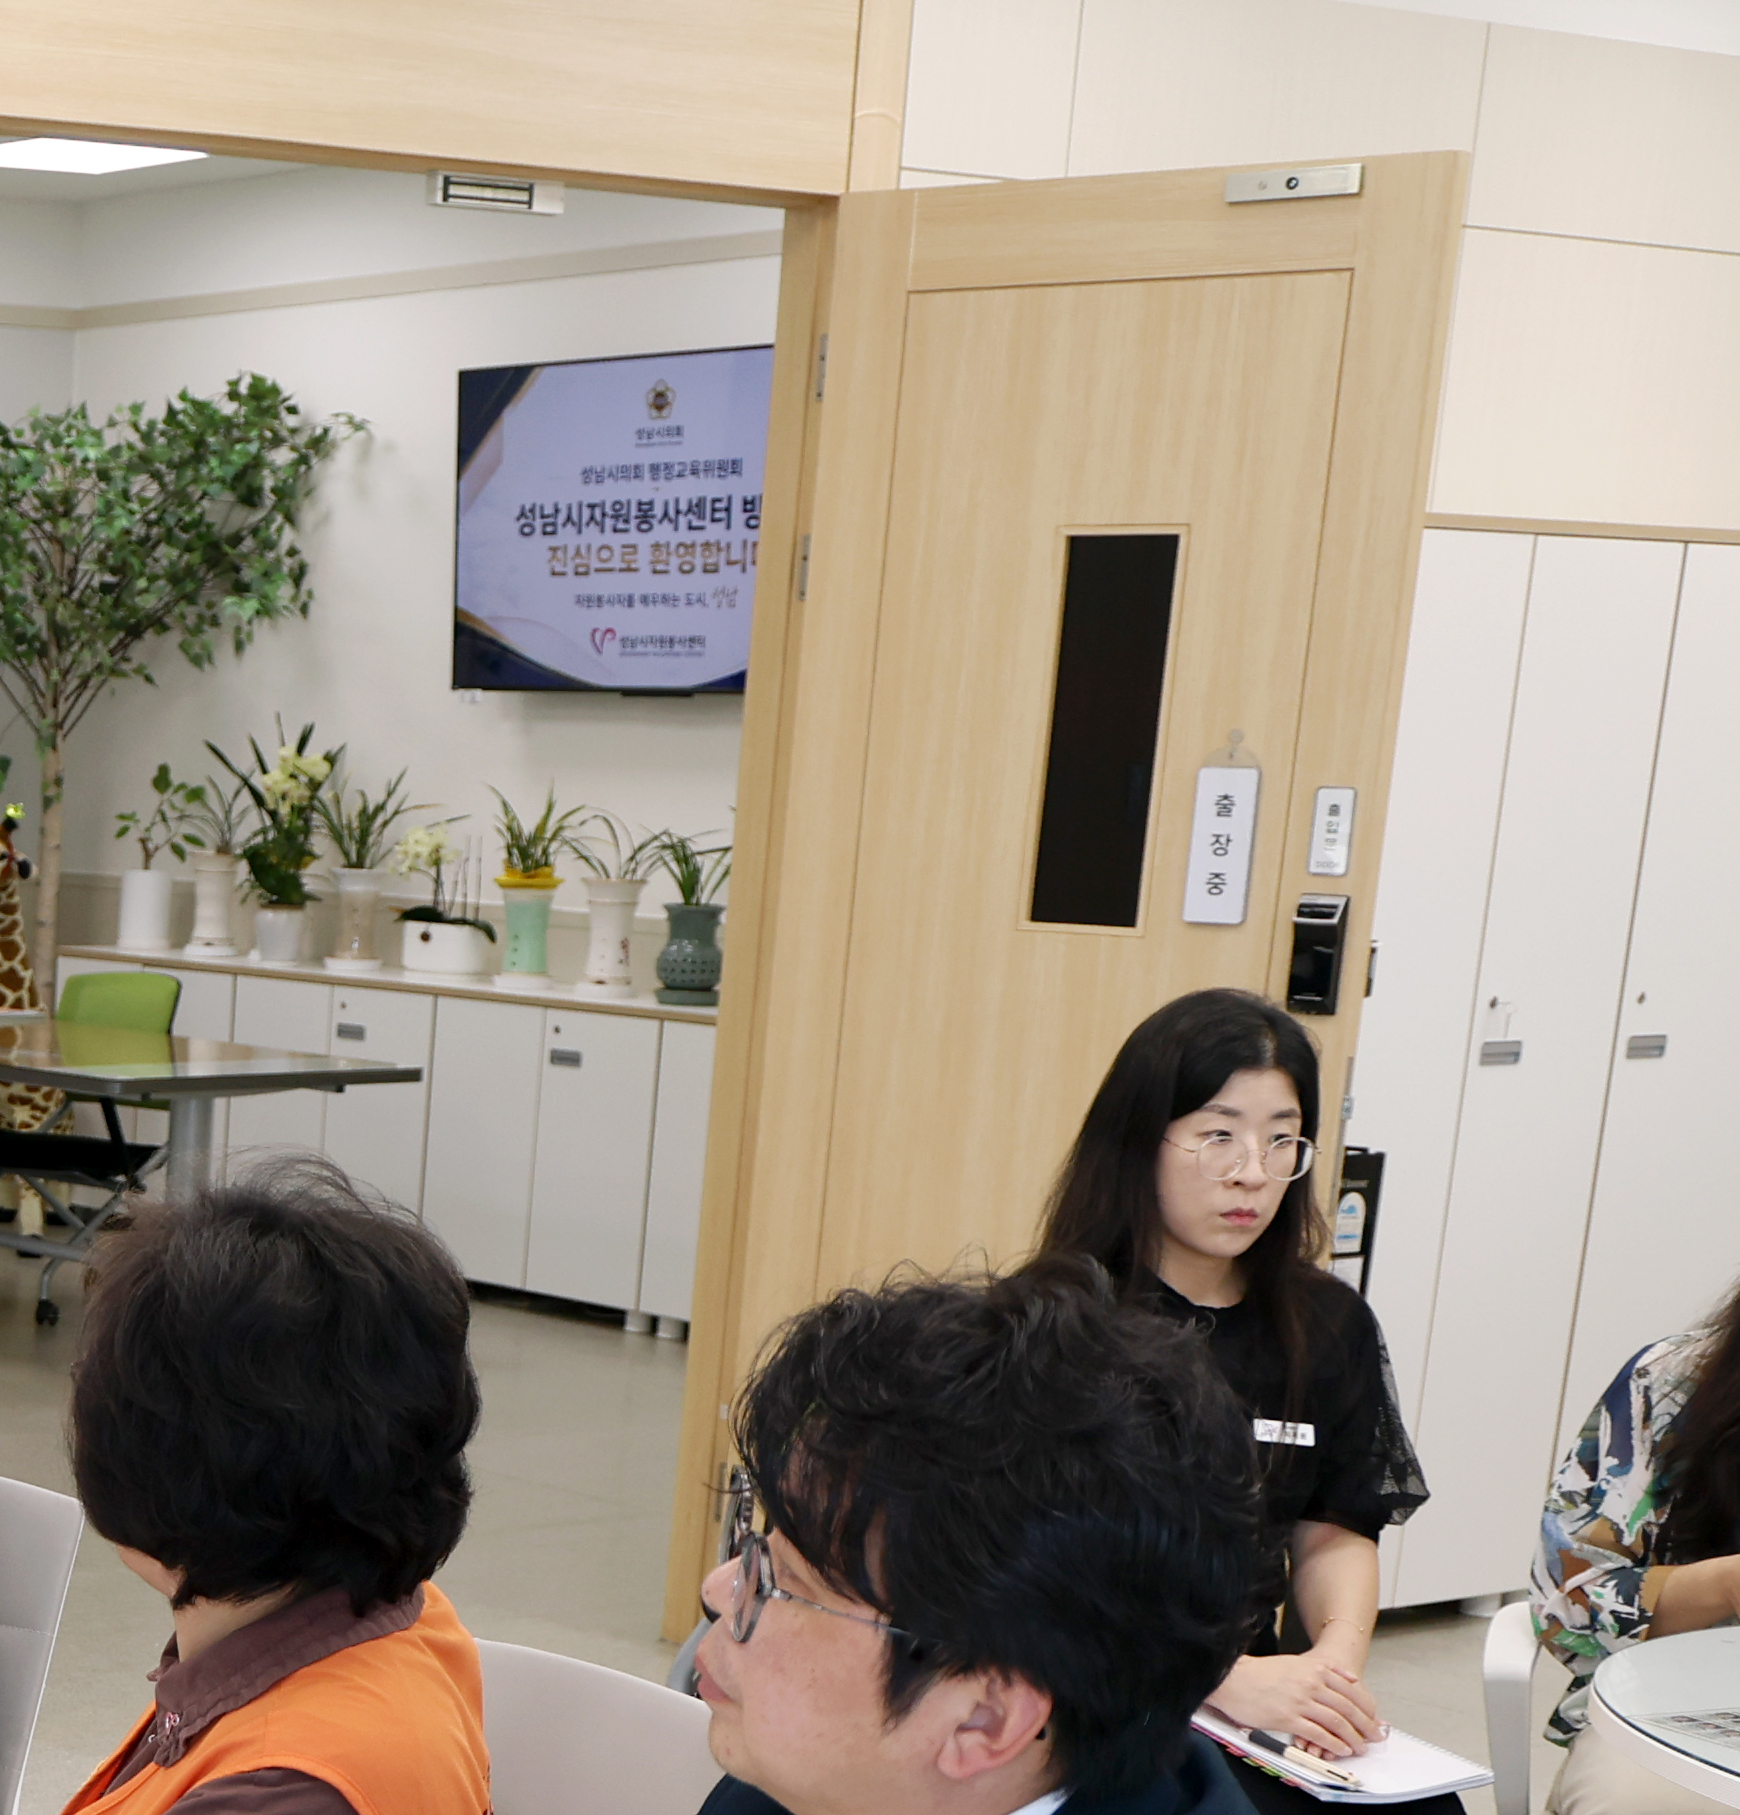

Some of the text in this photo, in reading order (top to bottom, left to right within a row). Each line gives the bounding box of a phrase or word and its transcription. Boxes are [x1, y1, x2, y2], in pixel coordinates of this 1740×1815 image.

[580, 461, 645, 484] 성남시의회
[515, 496, 733, 537] 성남시자원봉사센터
[547, 543, 639, 578] 진심으로
[1206, 794, 1236, 896] 출장중
